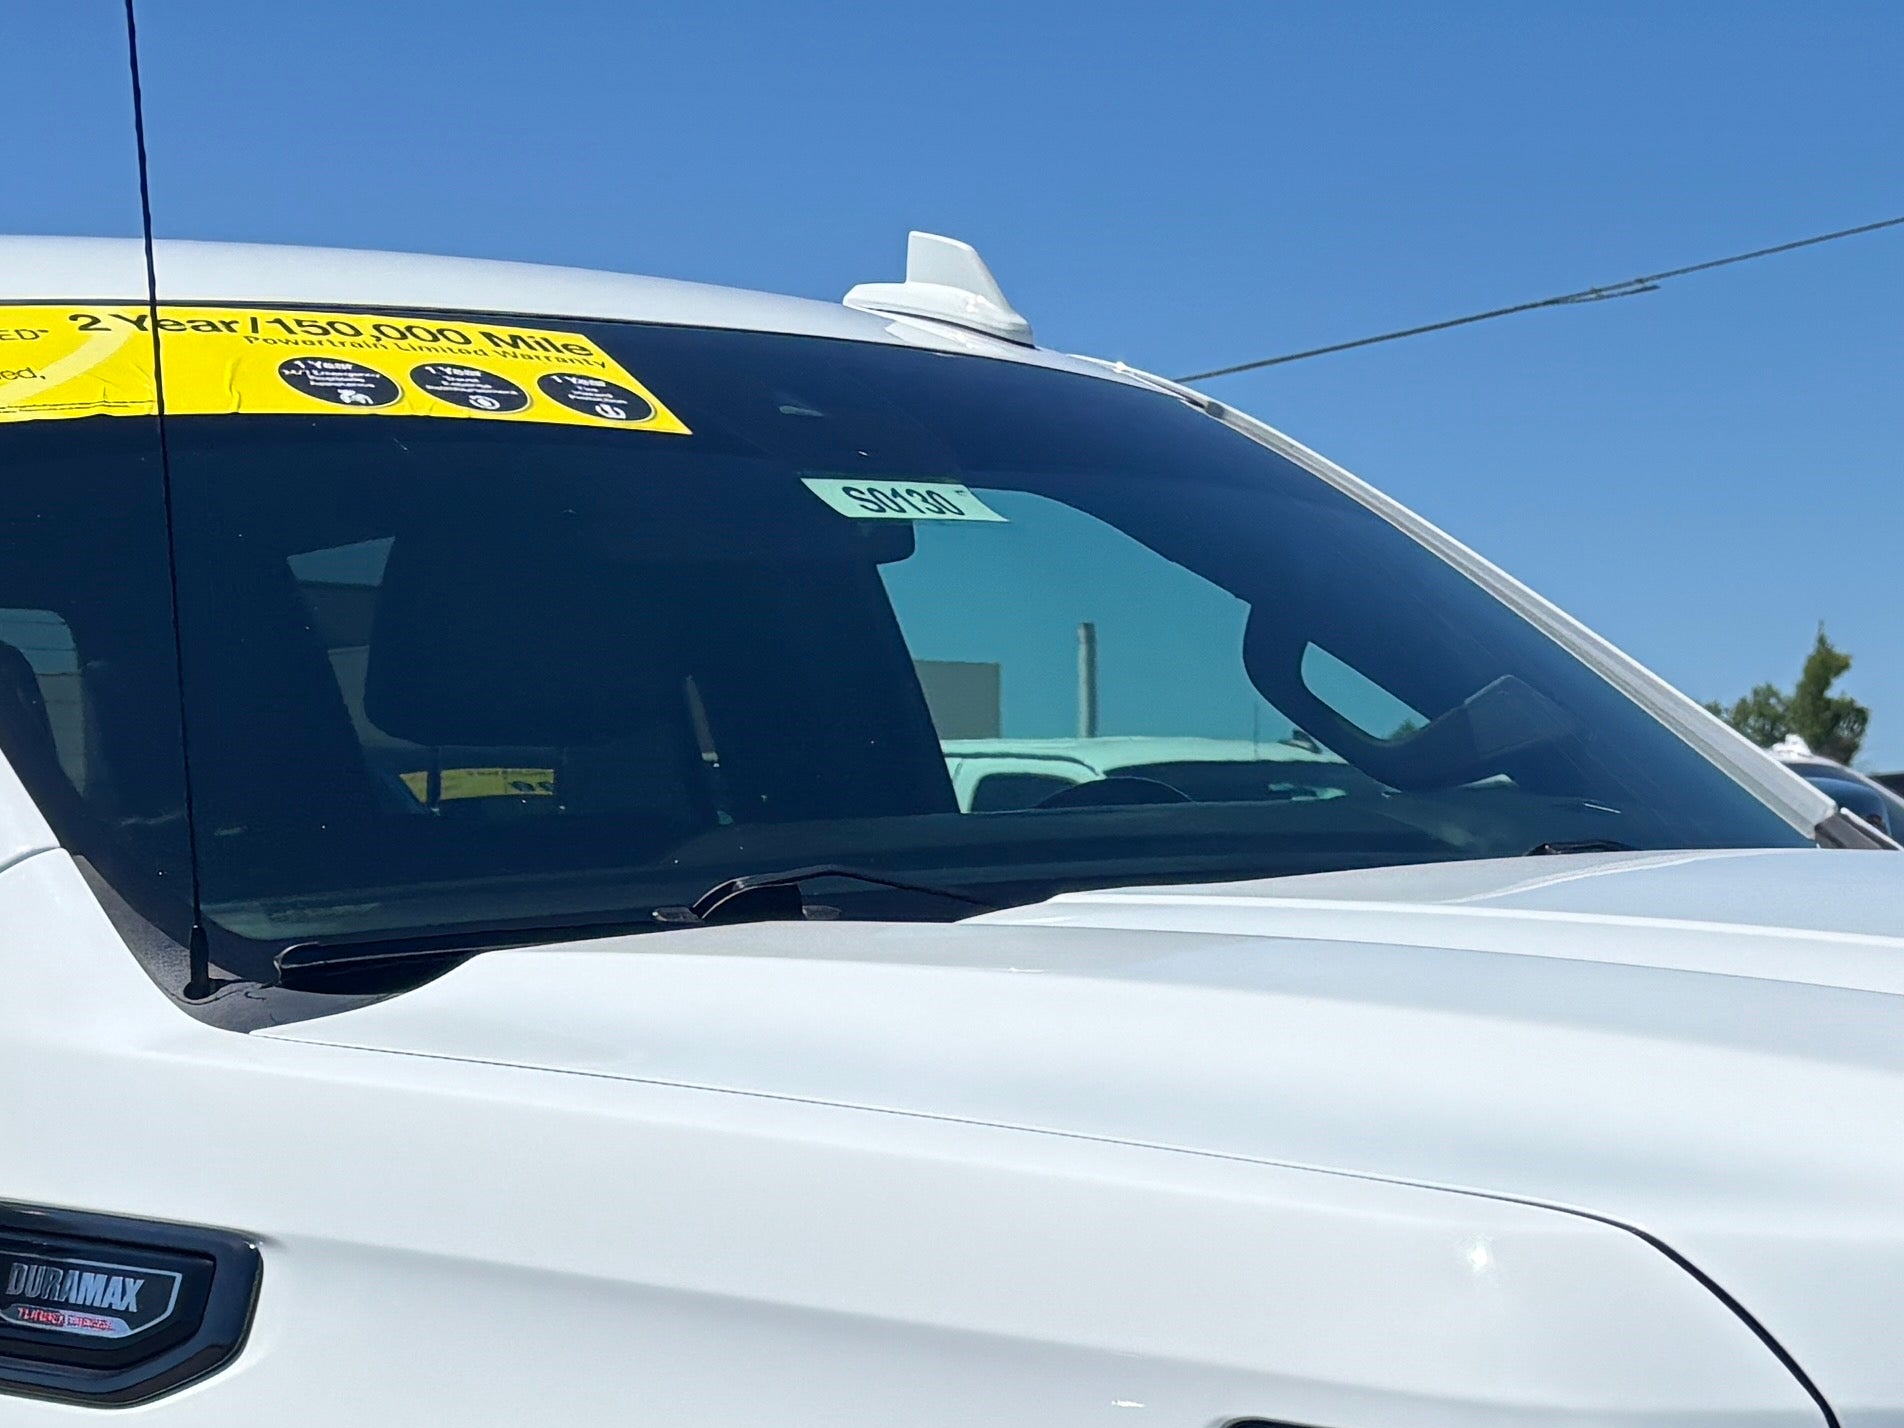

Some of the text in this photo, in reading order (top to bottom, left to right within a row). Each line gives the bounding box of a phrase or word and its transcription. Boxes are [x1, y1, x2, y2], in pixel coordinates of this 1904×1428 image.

[68, 313, 113, 332] 2
[479, 331, 595, 357] Mile
[244, 335, 607, 369] Powertrain Limited Warranty
[6, 1262, 145, 1313] DURAMAX
